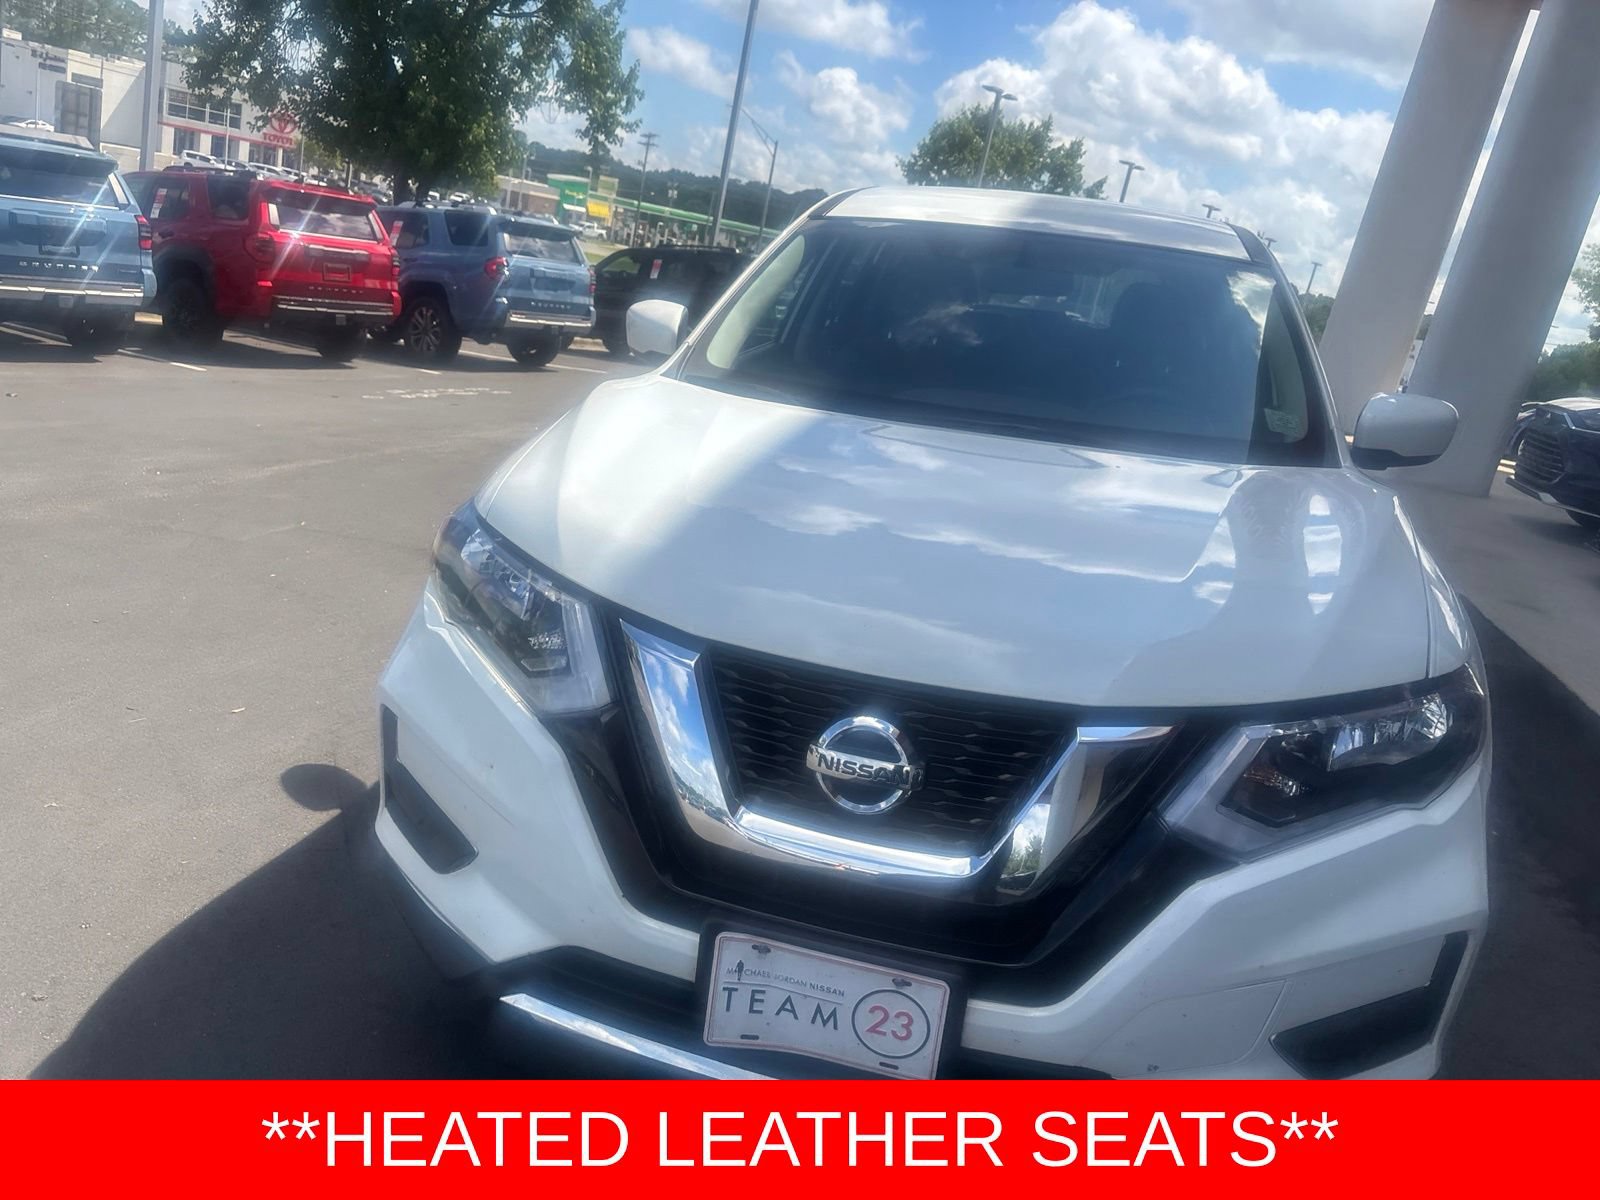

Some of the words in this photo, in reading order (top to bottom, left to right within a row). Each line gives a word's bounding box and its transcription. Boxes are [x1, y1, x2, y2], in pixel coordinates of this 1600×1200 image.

[263, 132, 296, 146] TOYOT
[817, 752, 910, 787] NISSAN
[774, 973, 807, 987] JORDAN
[809, 981, 845, 997] NISSAN
[722, 986, 839, 1031] TEAM
[865, 1004, 914, 1041] 23
